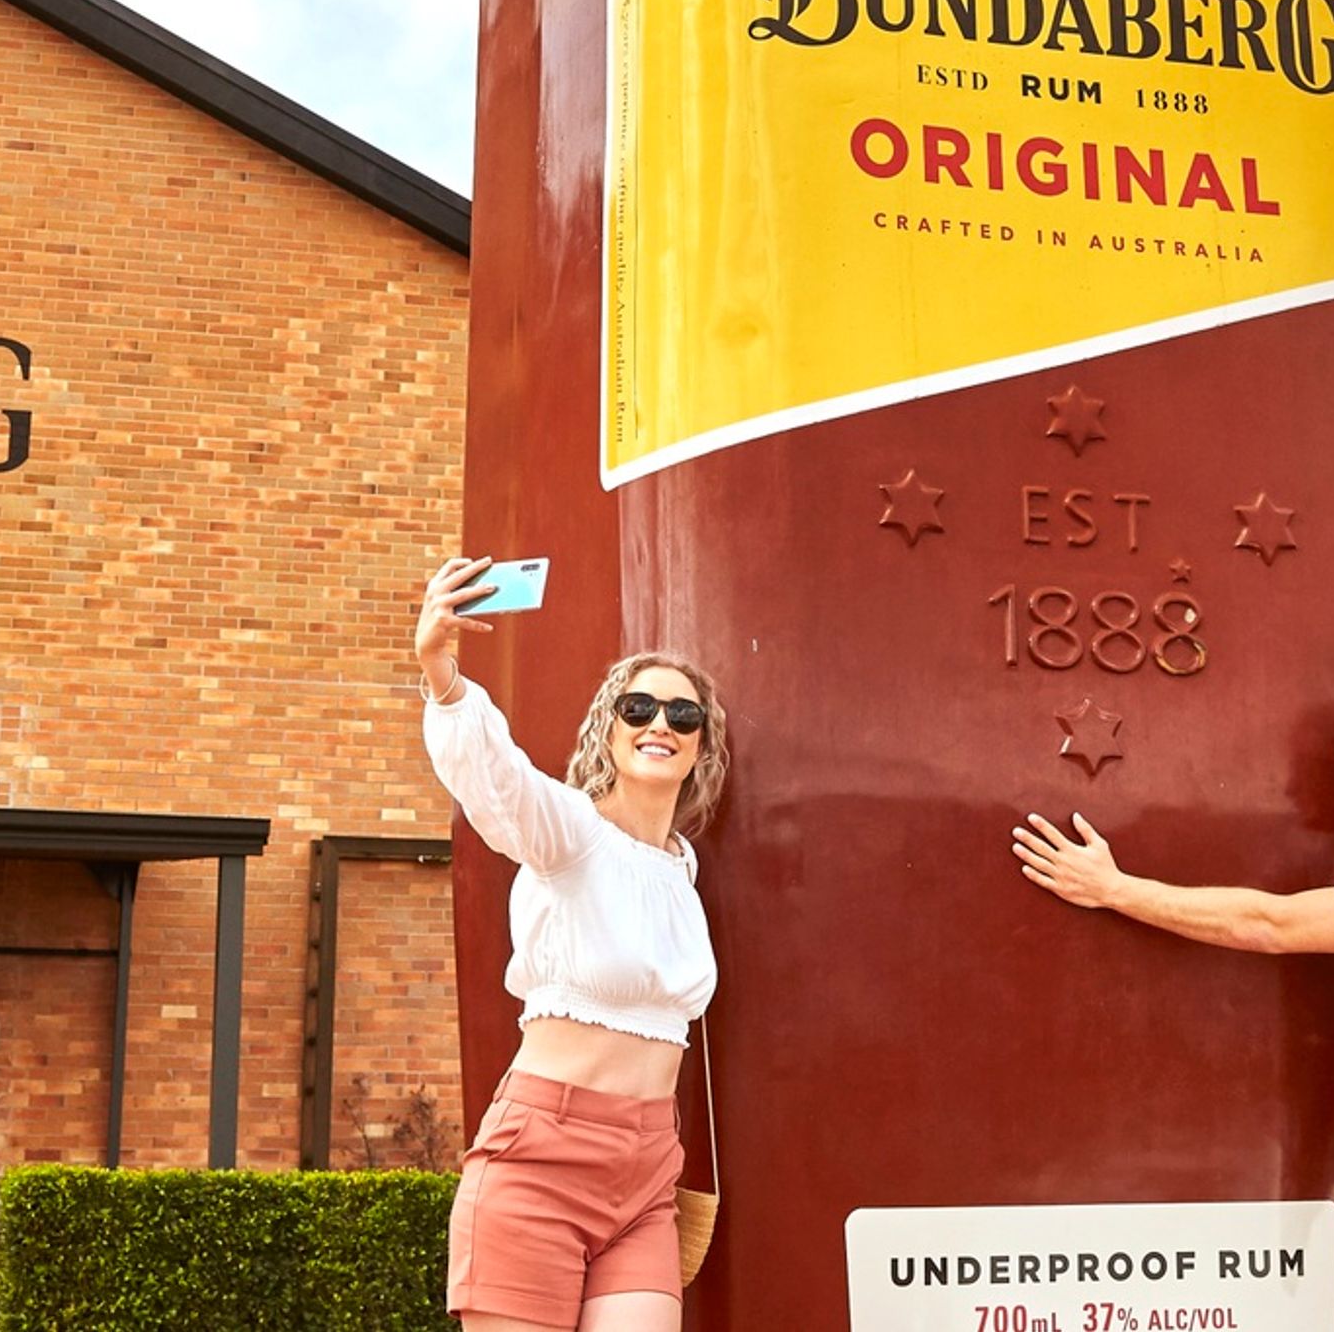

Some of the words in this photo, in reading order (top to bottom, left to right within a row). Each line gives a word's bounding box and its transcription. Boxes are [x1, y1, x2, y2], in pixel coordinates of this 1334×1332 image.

[916, 64, 990, 92] ESTD
[1021, 74, 1103, 105] RUM
[1135, 88, 1211, 115] 1888
[849, 118, 1281, 217] ORIGINAL
[615, 231, 627, 292] quality
[873, 212, 1014, 242] CRAFTED
[1037, 229, 1067, 248] IN
[1089, 234, 1265, 264] AUSTRALIA
[615, 300, 627, 395] Australian
[615, 401, 627, 443] Rum
[1022, 485, 1151, 553] EST
[987, 582, 1207, 676] 1888
[890, 1250, 1196, 1287] UNDERPROOF
[1218, 1248, 1306, 1279] RUM
[975, 1305, 1062, 1332] 700mL
[1082, 1302, 1139, 1332] 37%
[1148, 1308, 1238, 1332] ALC/VOL
